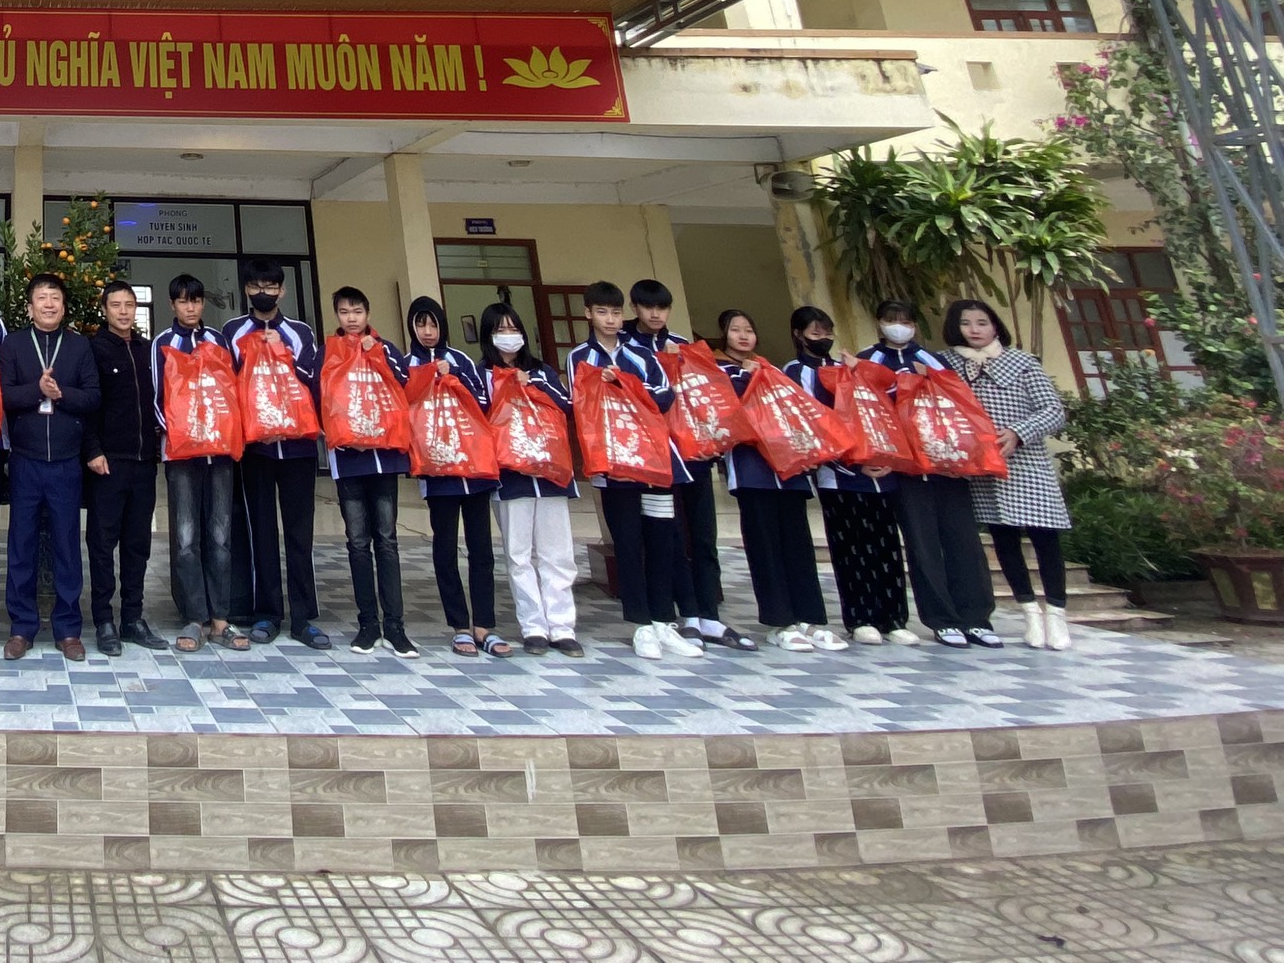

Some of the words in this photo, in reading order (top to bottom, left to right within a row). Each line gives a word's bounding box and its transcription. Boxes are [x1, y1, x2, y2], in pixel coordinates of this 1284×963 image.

[26, 32, 121, 88] NGHĨA
[129, 32, 193, 99] VIỆT
[204, 41, 277, 90] NAM
[285, 34, 382, 91] MUÔN
[390, 34, 466, 92] NĂM
[178, 222, 198, 232] SINH
